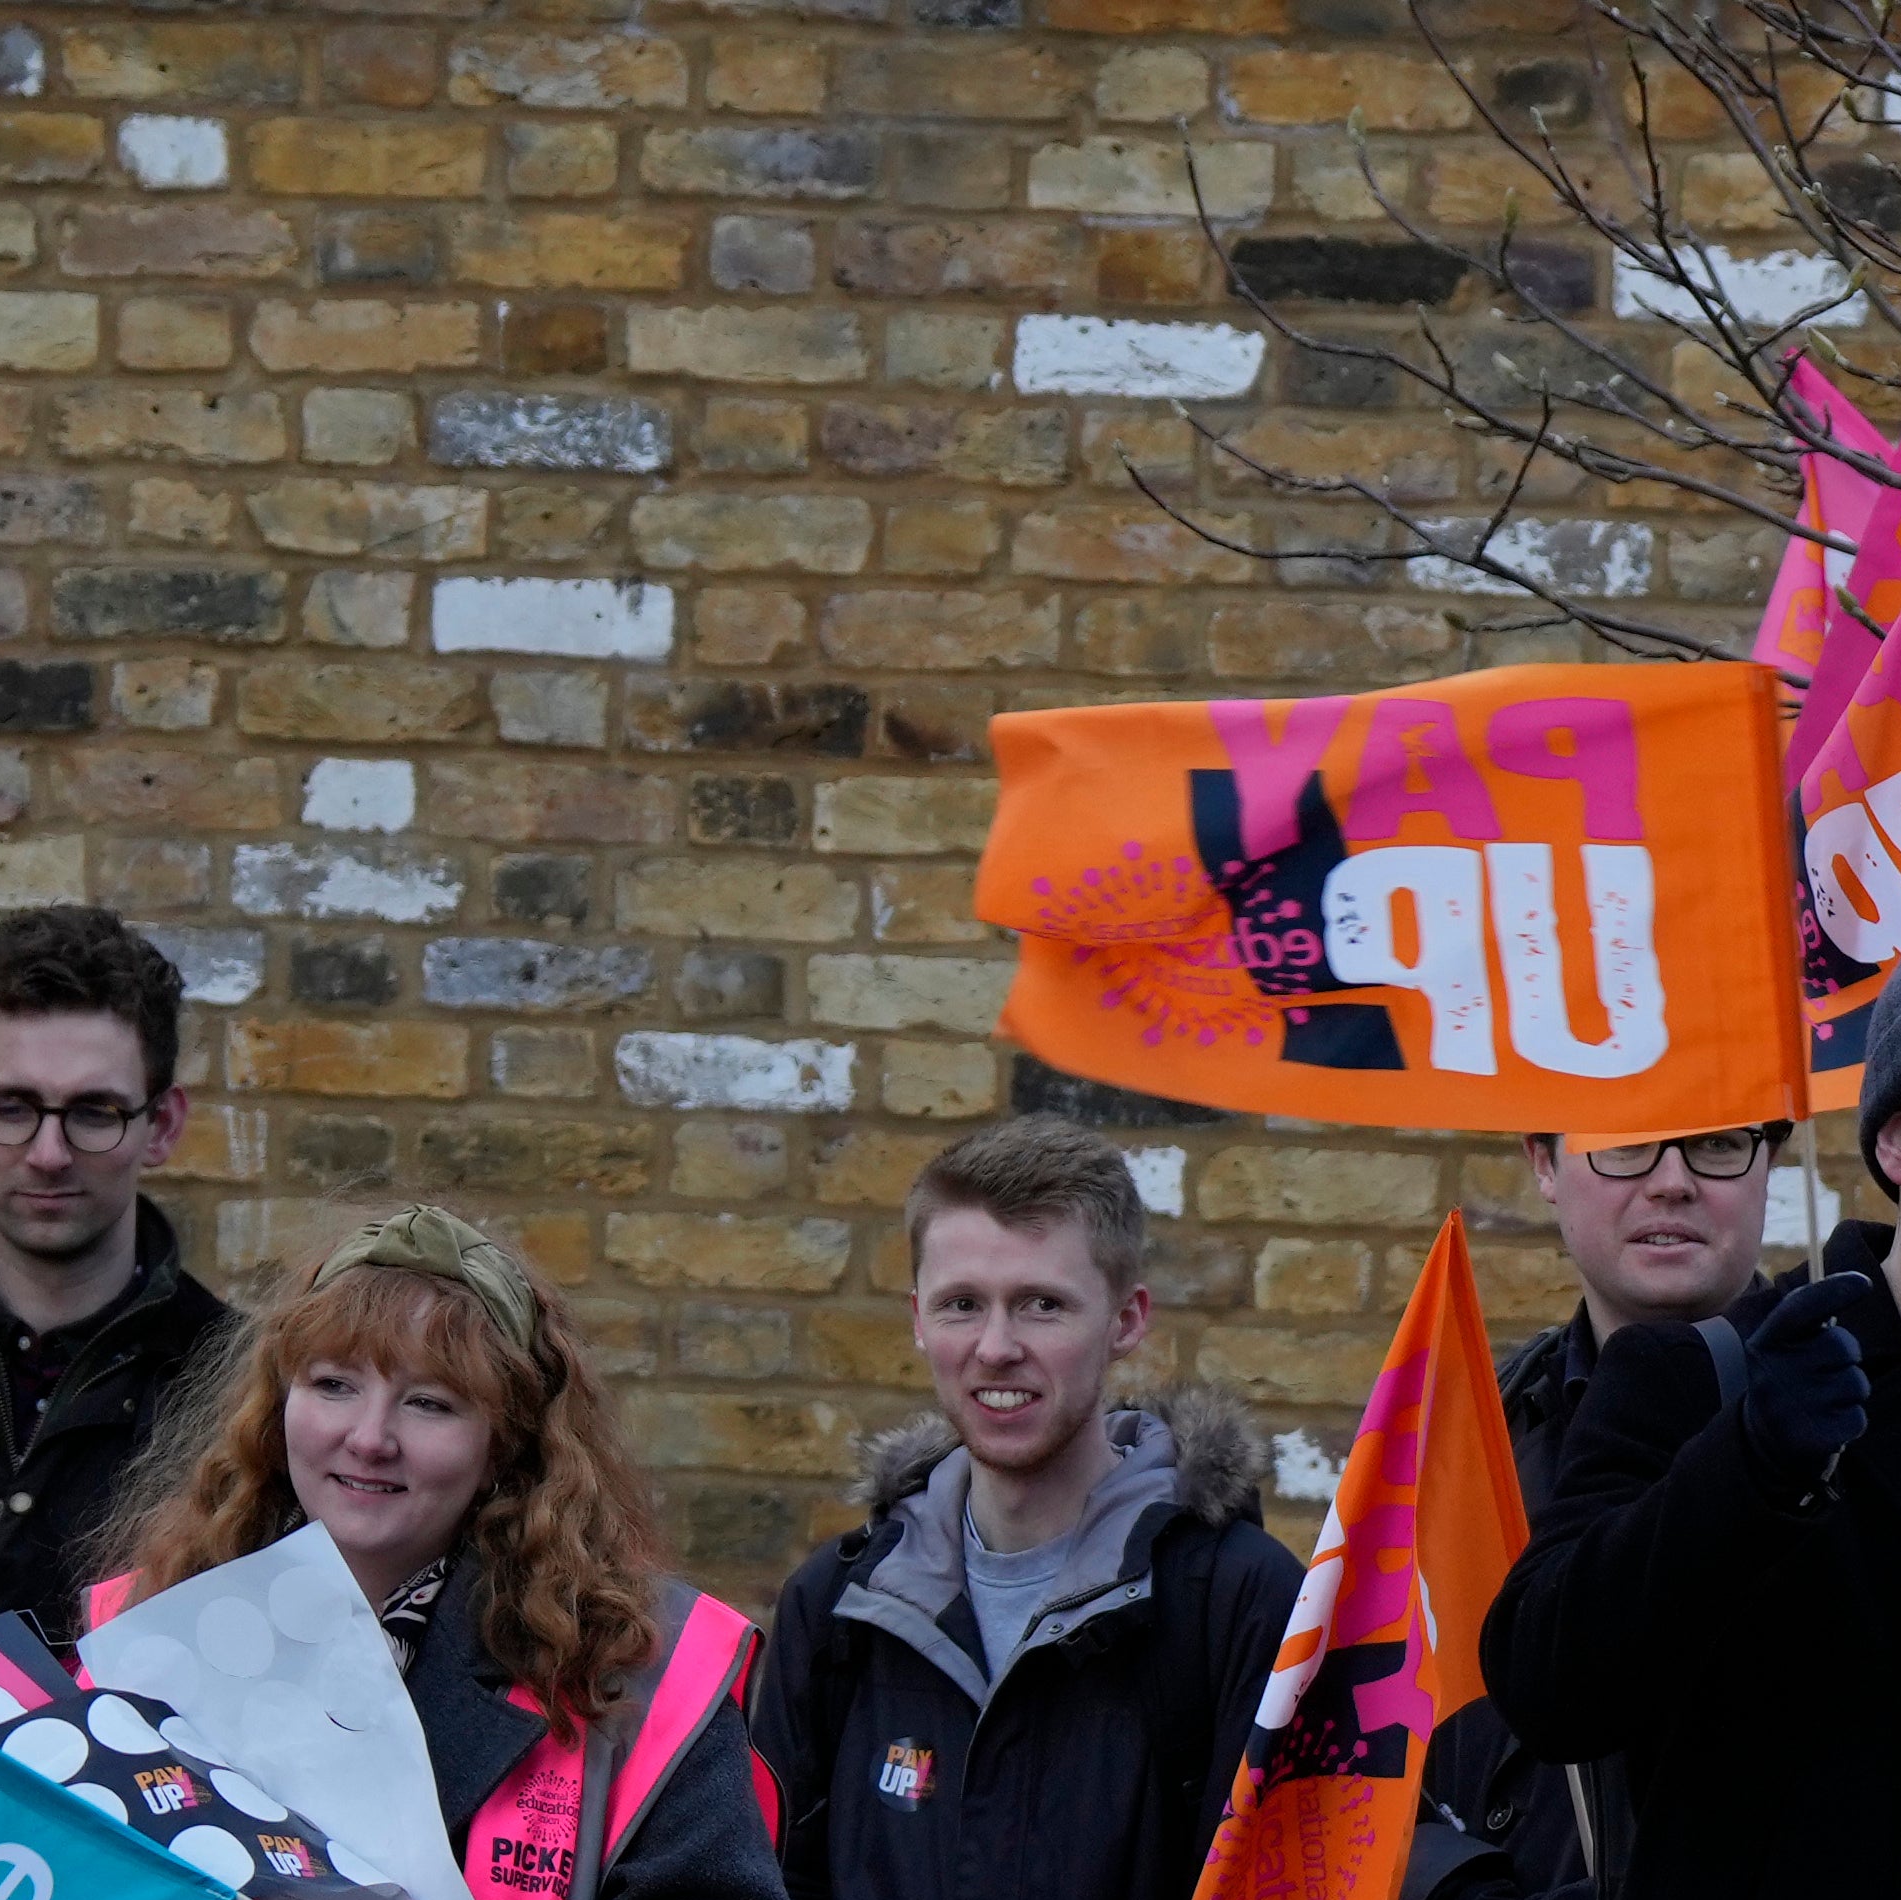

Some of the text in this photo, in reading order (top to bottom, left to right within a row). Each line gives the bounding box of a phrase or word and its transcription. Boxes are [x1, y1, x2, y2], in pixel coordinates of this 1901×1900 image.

[886, 1744, 933, 1770] PAY
[133, 1765, 184, 1791] PAY
[257, 1834, 301, 1853] PAY
[491, 1836, 575, 1880] PICKE
[490, 1865, 571, 1900] SUPERVISO
